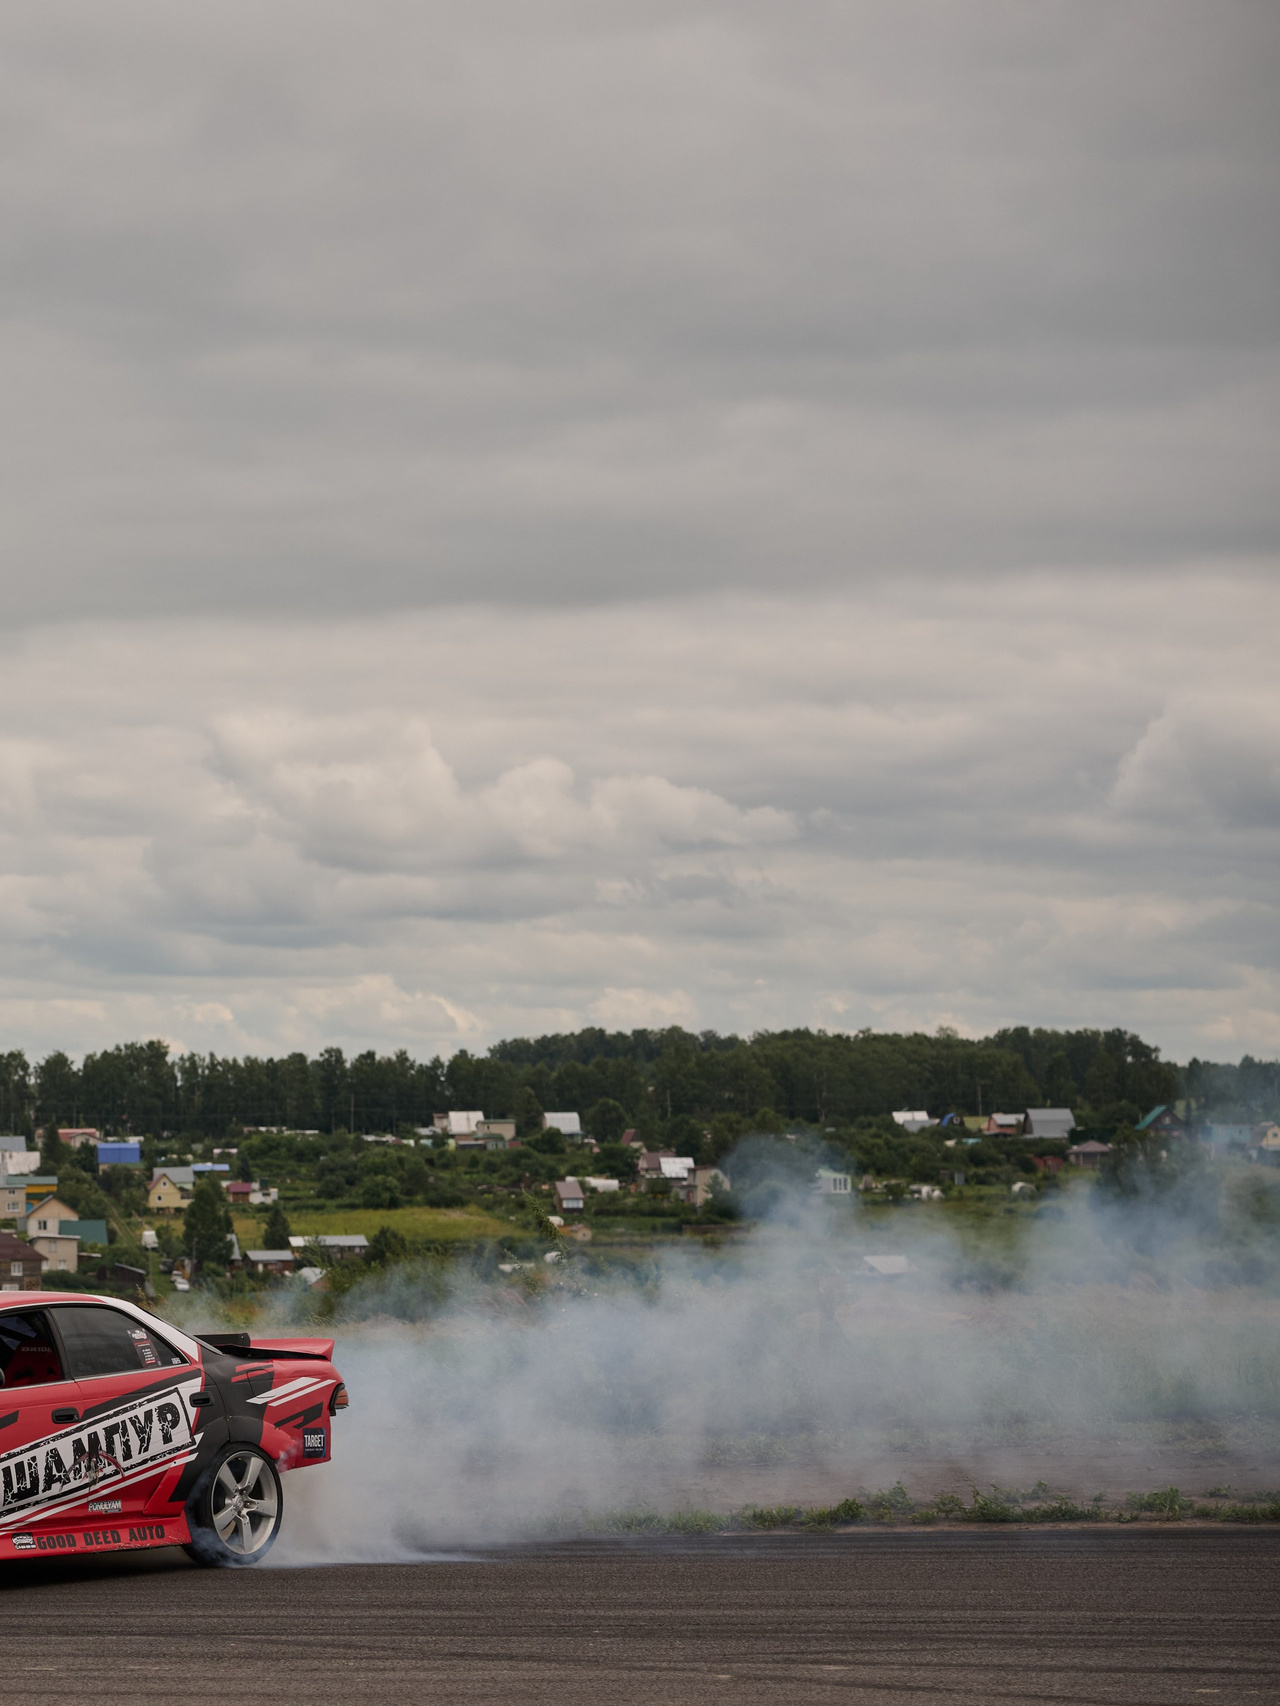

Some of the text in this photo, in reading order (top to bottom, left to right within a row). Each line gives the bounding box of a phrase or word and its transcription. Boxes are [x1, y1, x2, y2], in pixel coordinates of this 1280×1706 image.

[1, 1402, 181, 1506] ШАМПУР
[303, 1434, 325, 1448] TARGET
[36, 1524, 165, 1550] GOOD DEED AUTO
